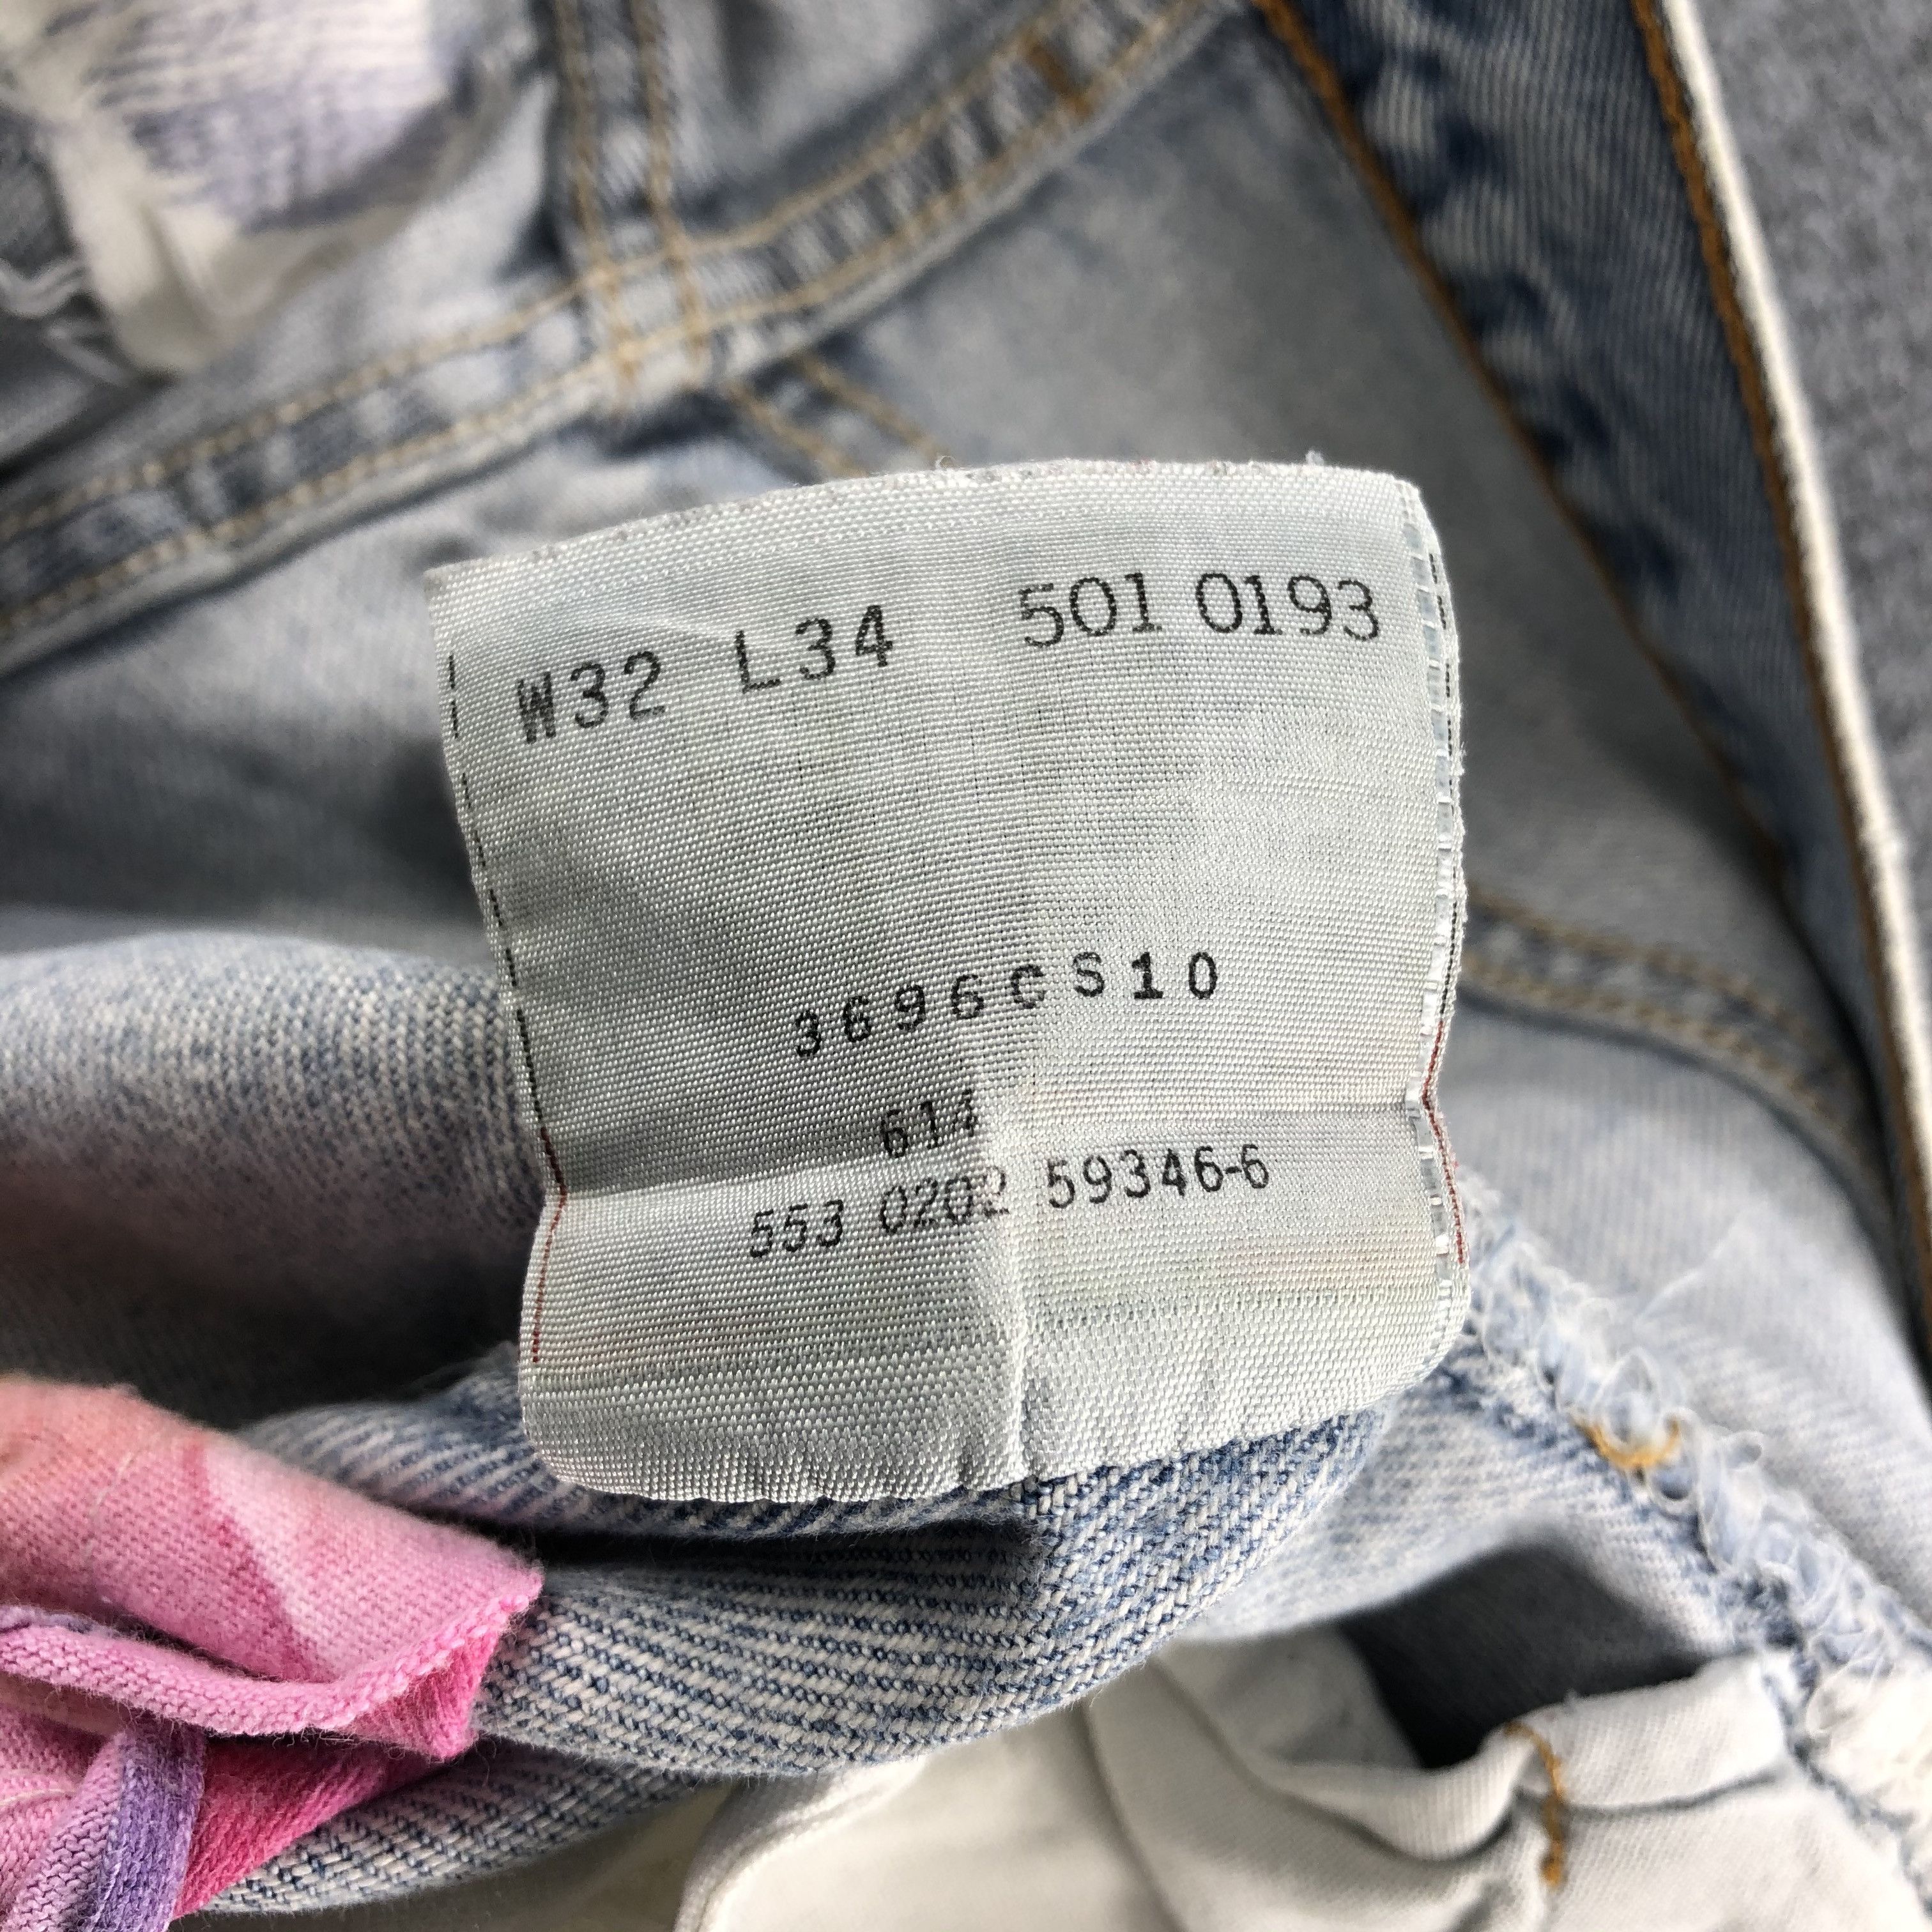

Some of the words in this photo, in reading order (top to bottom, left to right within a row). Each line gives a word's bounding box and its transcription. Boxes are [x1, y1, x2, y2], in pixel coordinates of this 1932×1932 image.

[517, 650, 666, 744] W32
[734, 604, 893, 694] L34
[1020, 572, 1162, 648] 501
[1195, 572, 1380, 641] 0193
[749, 1198, 845, 1259] 553
[879, 1165, 1010, 1235] 0202
[1047, 1144, 1270, 1209] 59346-6
